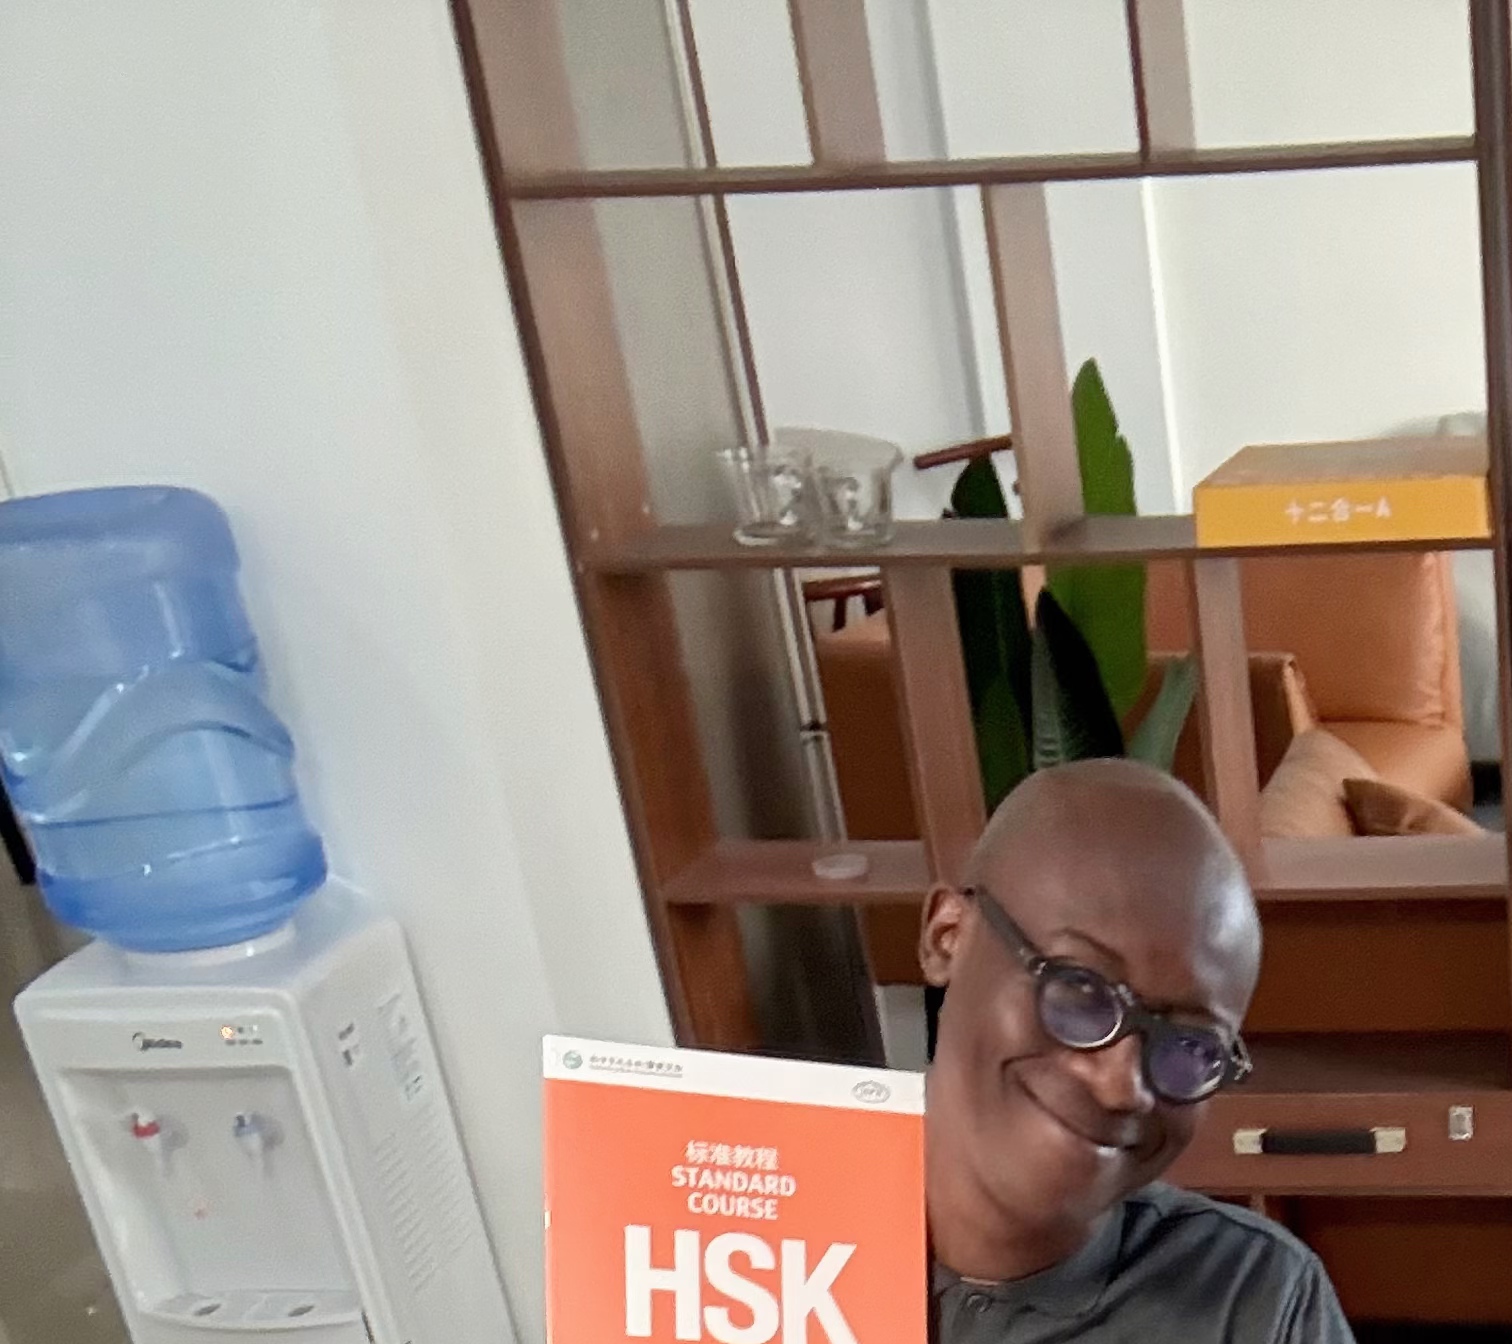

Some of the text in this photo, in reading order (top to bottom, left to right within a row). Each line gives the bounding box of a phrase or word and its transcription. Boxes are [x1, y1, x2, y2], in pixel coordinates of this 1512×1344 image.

[685, 1139, 780, 1171] 标准教程
[671, 1165, 797, 1197] STANDARD
[687, 1191, 779, 1221] COURSE
